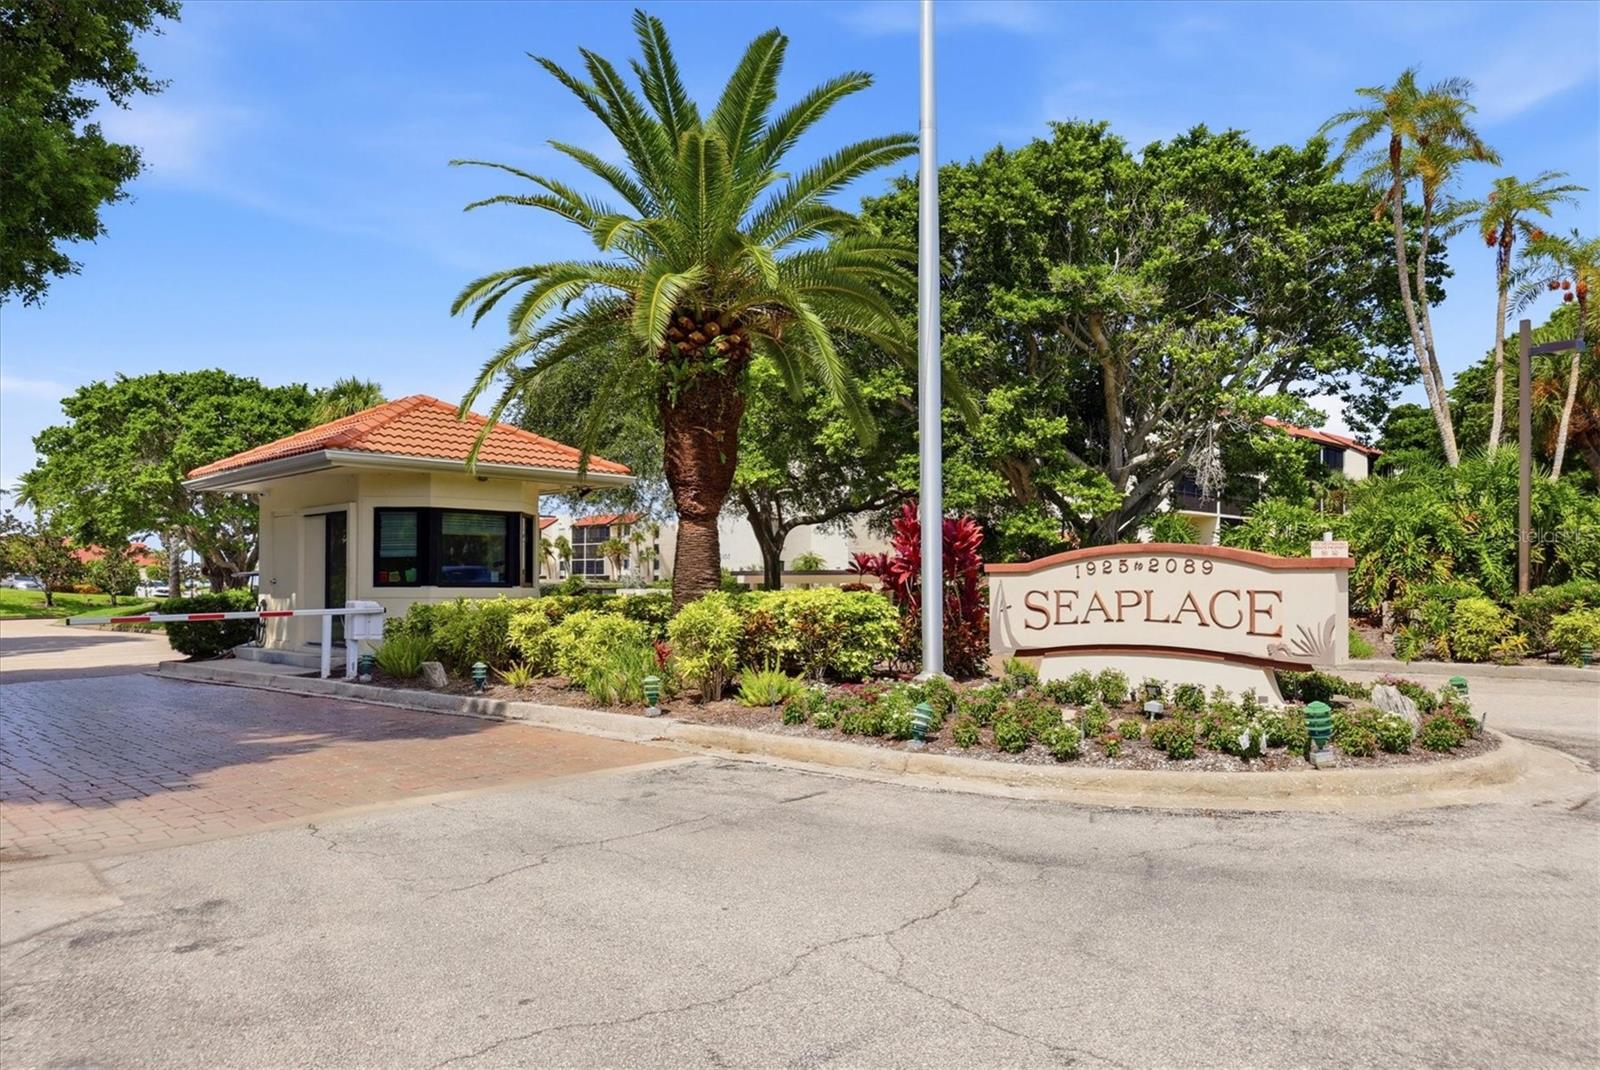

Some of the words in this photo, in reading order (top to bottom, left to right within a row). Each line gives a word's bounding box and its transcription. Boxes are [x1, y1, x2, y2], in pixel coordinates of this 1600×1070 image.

[1075, 558, 1129, 579] 1925
[1134, 560, 1144, 571] to
[1148, 557, 1214, 575] 2089
[1024, 589, 1283, 638] SEAPLACE
